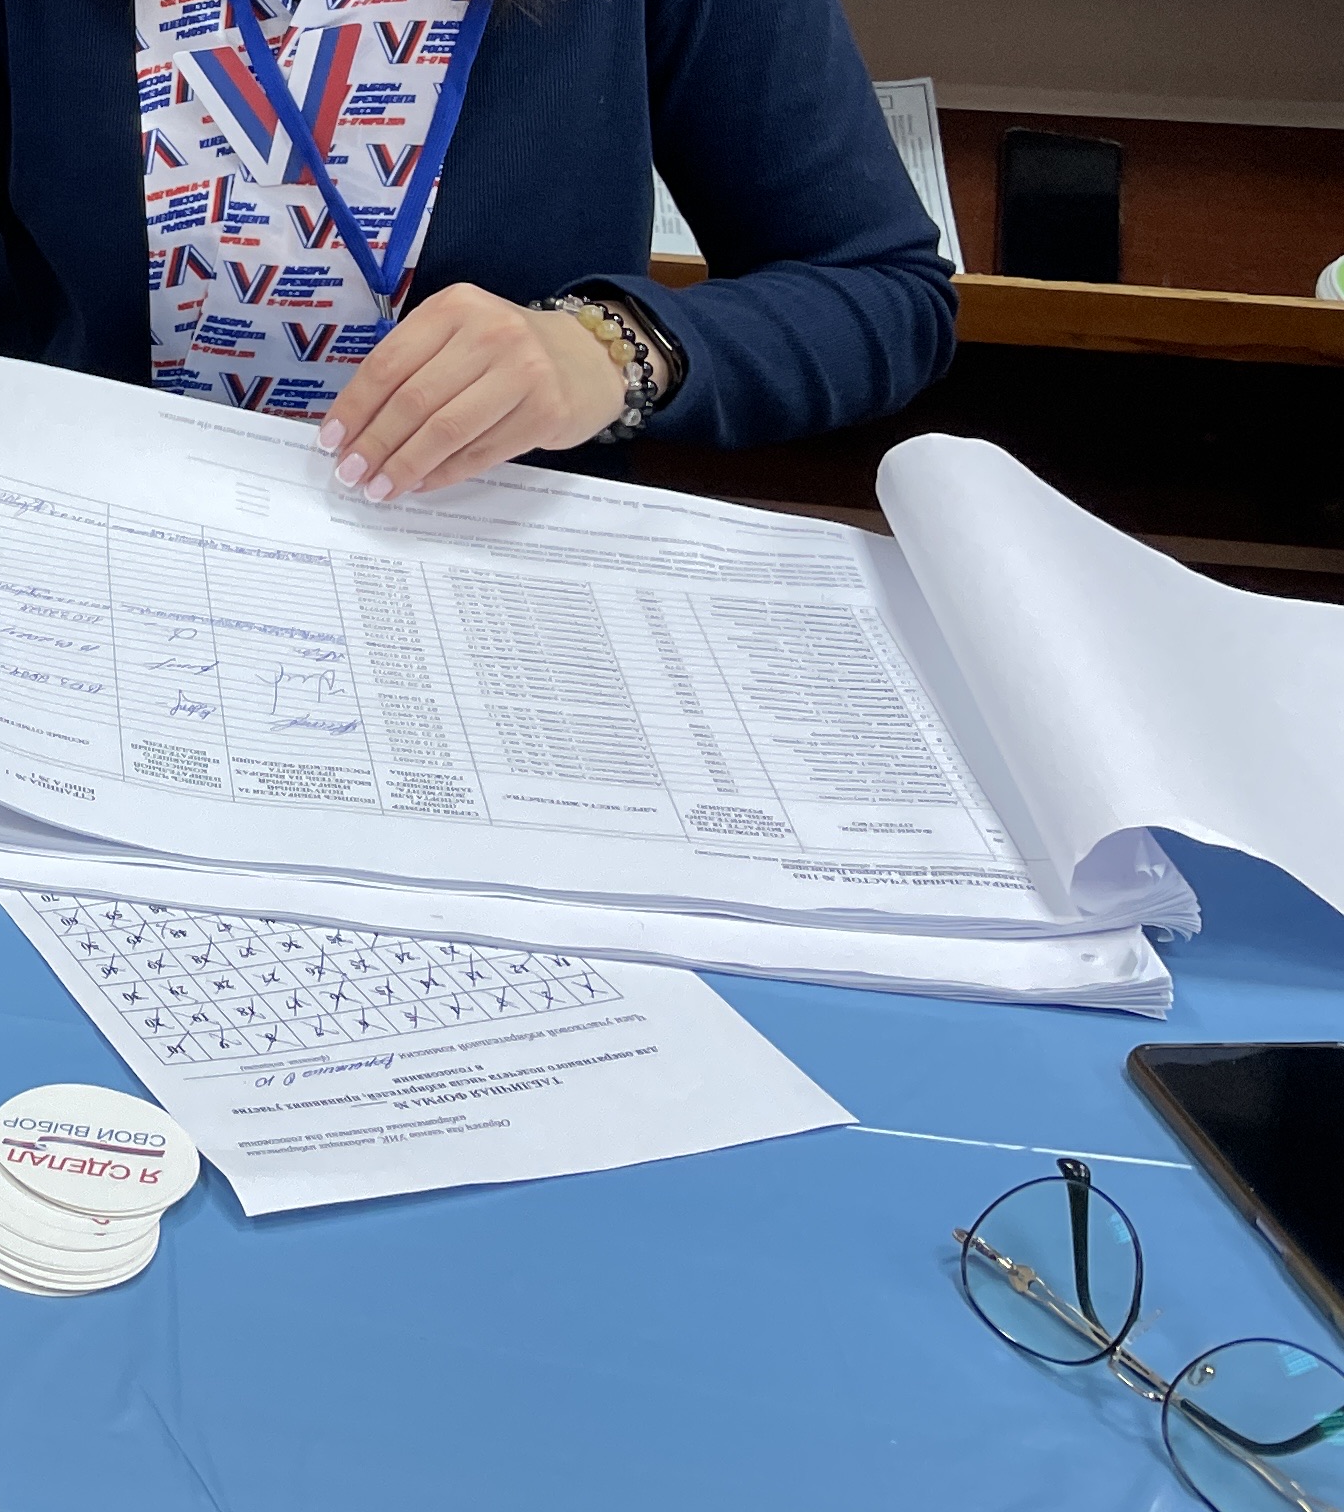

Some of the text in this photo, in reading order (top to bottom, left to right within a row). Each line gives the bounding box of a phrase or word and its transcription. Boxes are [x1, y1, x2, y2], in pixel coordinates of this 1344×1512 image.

[546, 1017, 614, 1038] участковой
[457, 1030, 543, 1052] избирательной
[398, 1044, 456, 1061] комиссии
[547, 1049, 633, 1072] оперативного
[392, 1065, 473, 1085] голосовании
[448, 1075, 486, 1089] числа
[488, 1065, 545, 1082] подсчета
[361, 1082, 446, 1102] избирателей,
[469, 1075, 563, 1099] ТАБЛИЧНАЯ
[232, 1102, 284, 1116] участие
[285, 1095, 360, 1111] принявших
[412, 1090, 467, 1109] ФОРМА
[3, 1117, 166, 1147] СВОЙ ВЫБОР
[8, 1148, 162, 1184] Я СДЕЛАЛ
